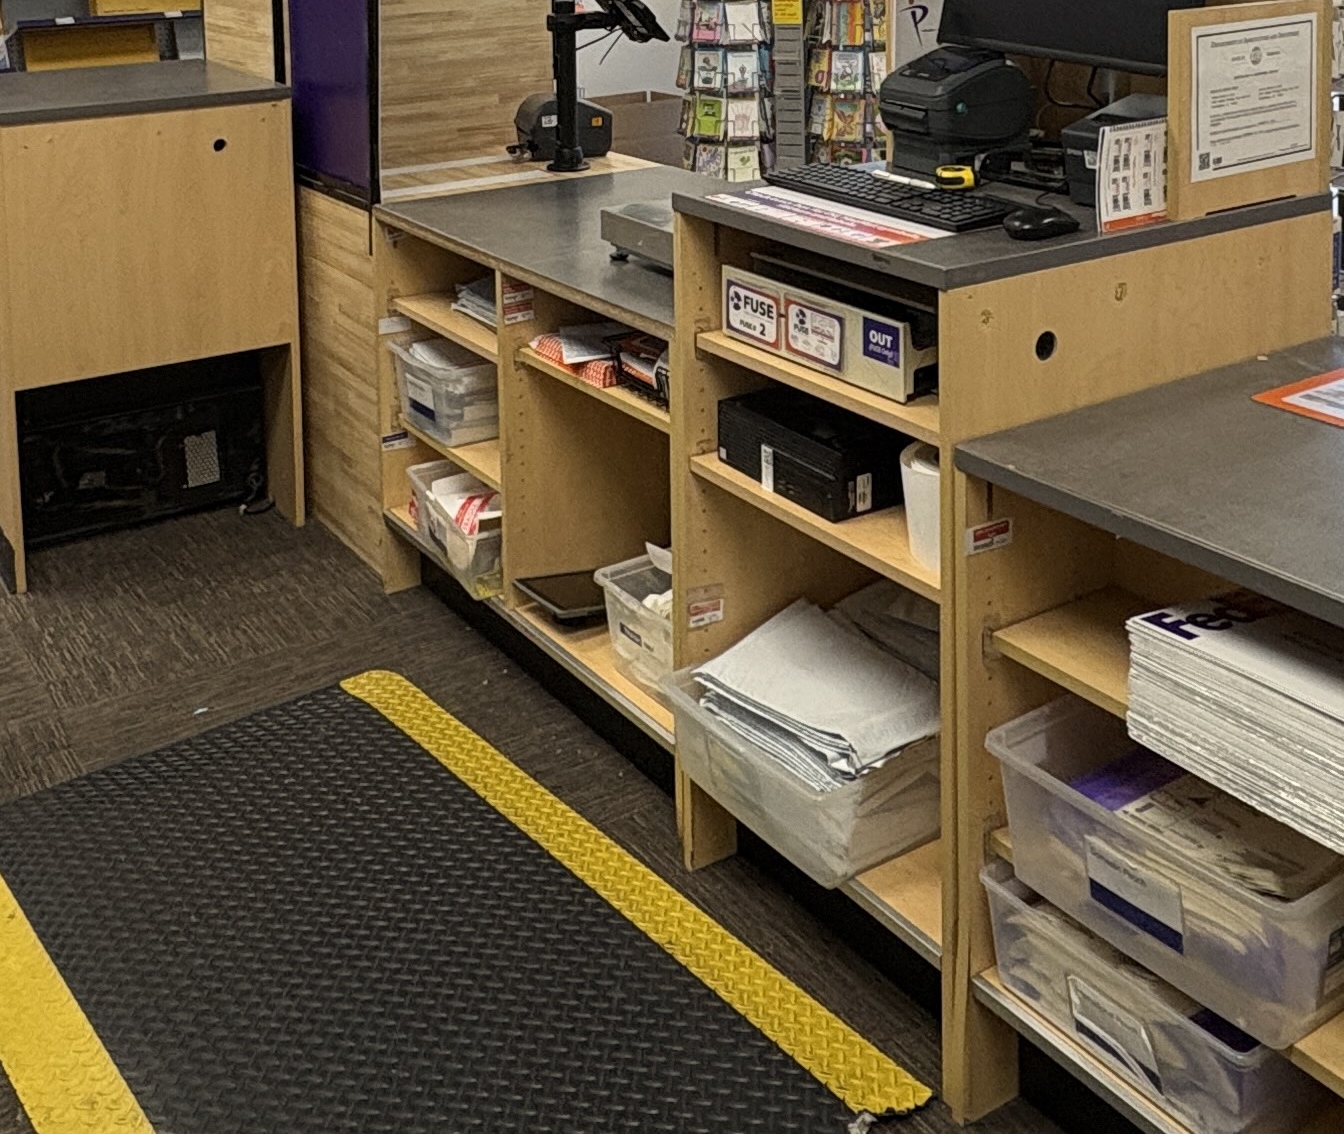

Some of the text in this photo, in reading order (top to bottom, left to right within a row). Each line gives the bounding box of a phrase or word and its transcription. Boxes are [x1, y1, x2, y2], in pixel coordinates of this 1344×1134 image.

[743, 294, 775, 321] FUSE
[759, 322, 767, 337] 2
[868, 328, 894, 348] OUT
